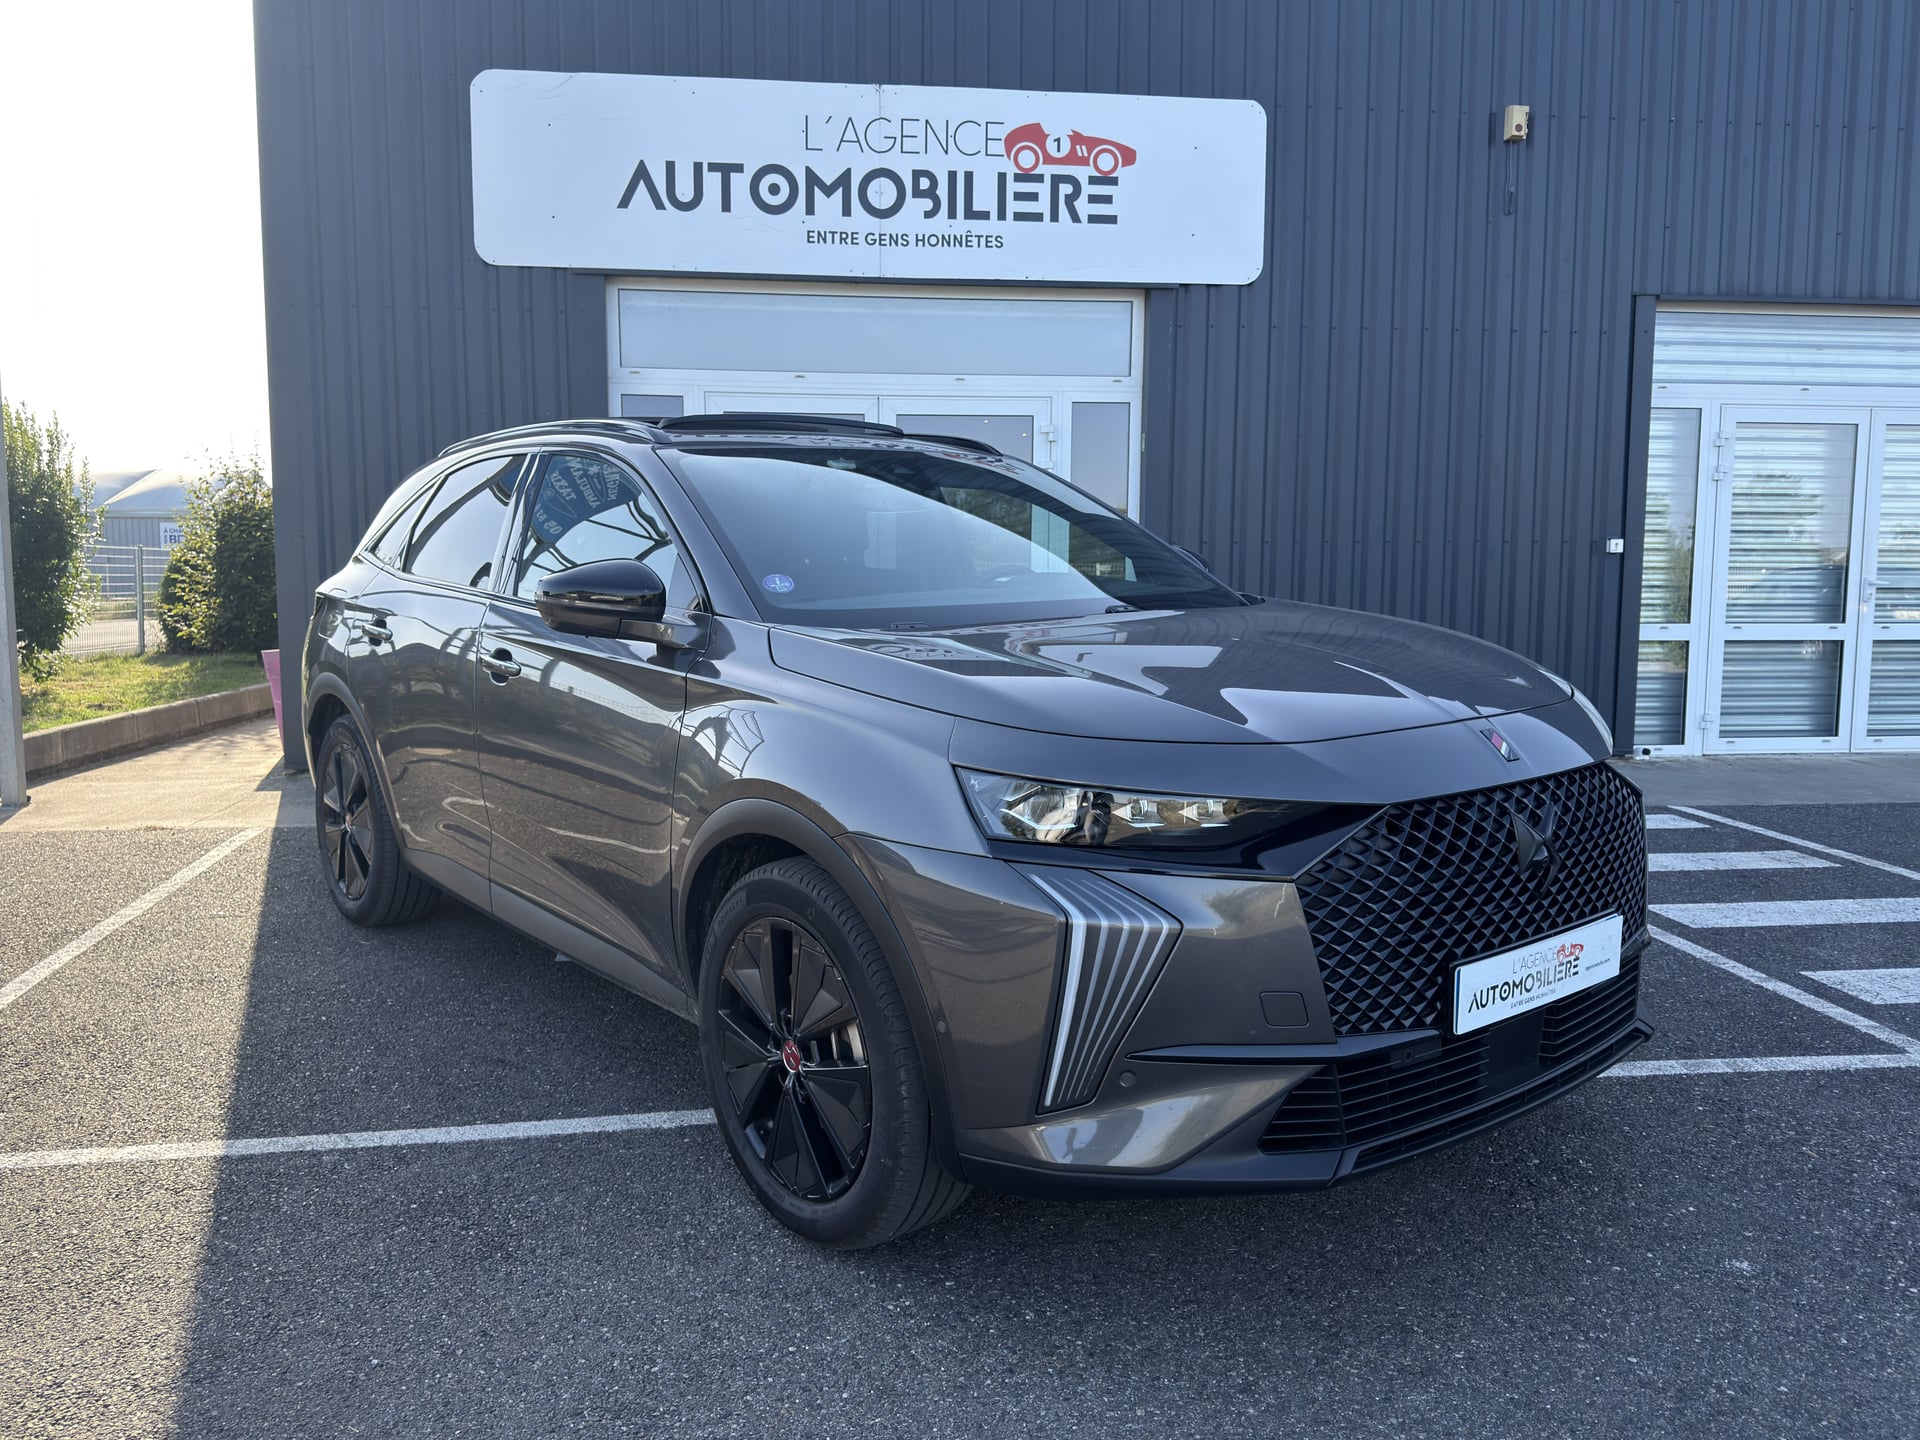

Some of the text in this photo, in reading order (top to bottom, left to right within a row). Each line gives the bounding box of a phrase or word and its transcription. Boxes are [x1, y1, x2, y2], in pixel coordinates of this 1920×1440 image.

[805, 115, 1005, 157] L'AGENCE
[1052, 137, 1063, 154] 1
[616, 159, 1119, 225] AUTOMOBILIERE
[806, 230, 1004, 250] ENTRE GENS HONNÊTES
[1468, 957, 1580, 1013] AUTOMOBILIERE
